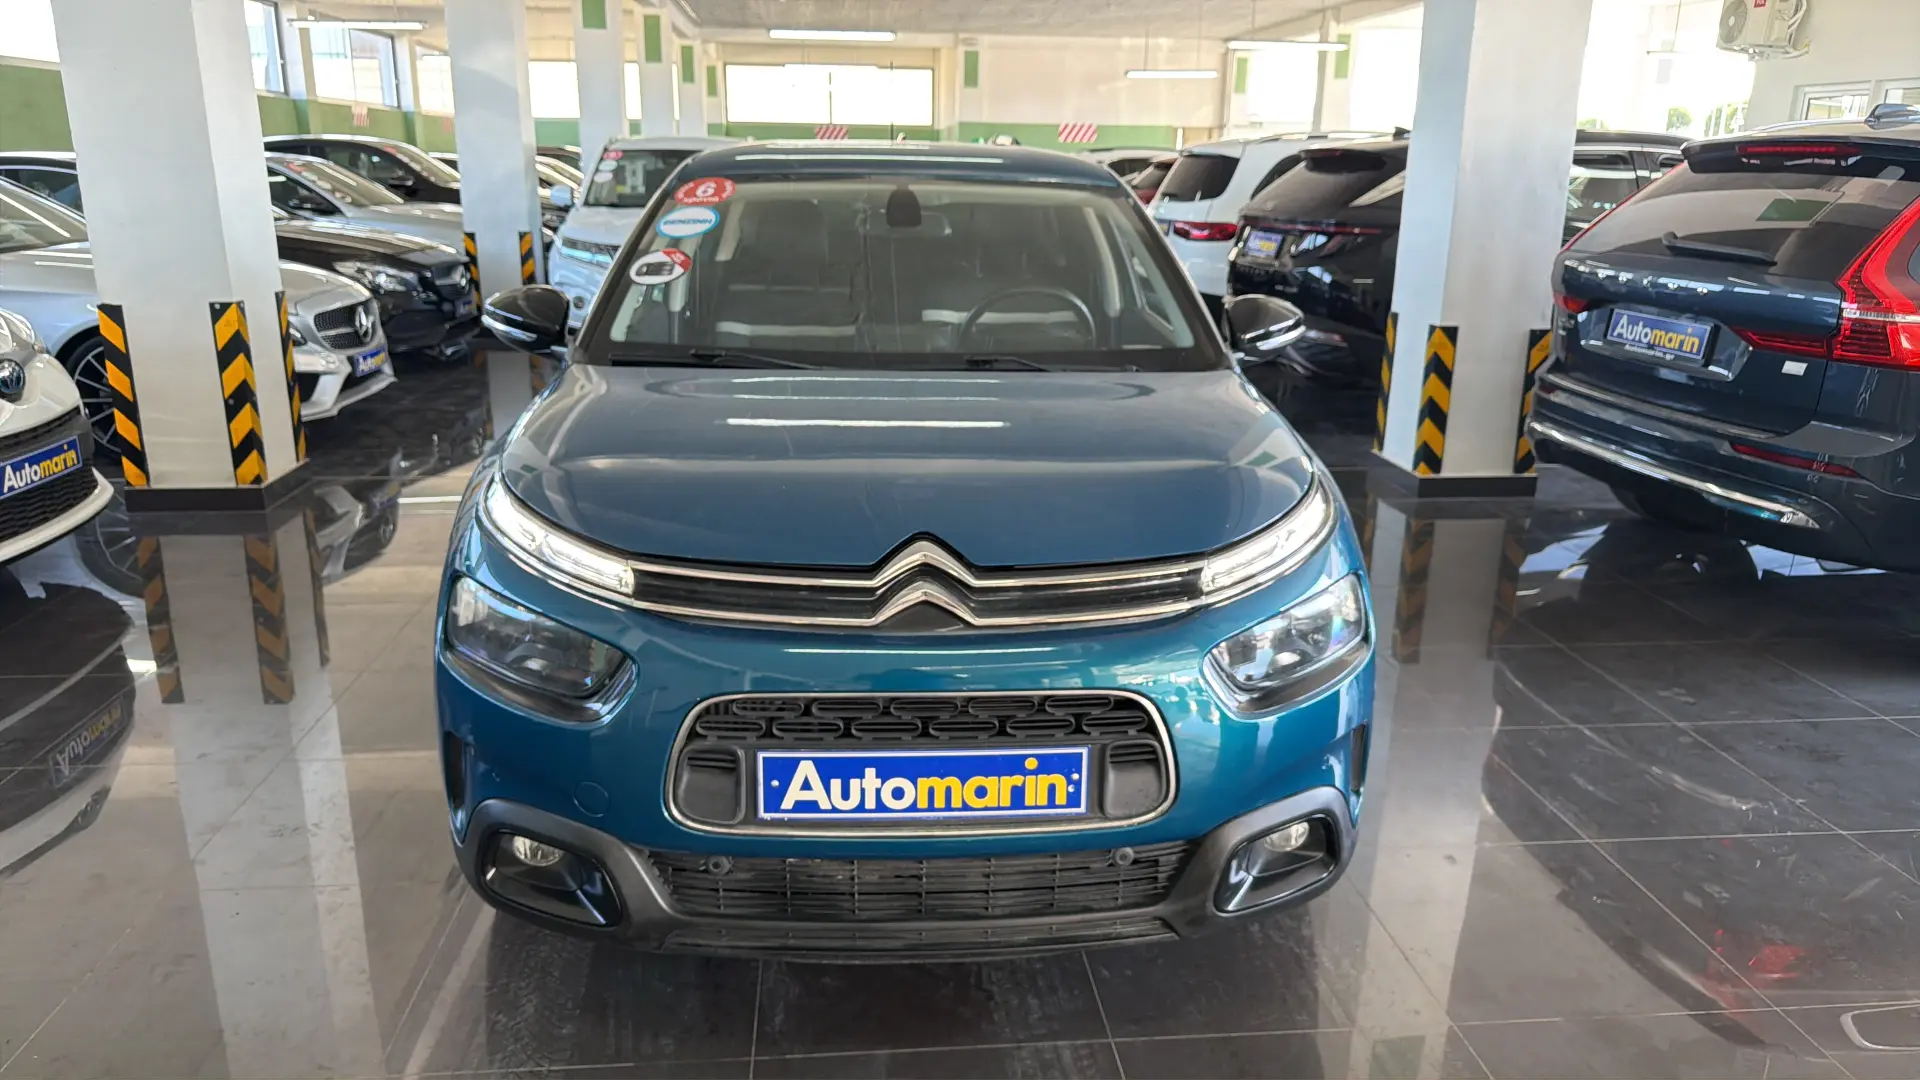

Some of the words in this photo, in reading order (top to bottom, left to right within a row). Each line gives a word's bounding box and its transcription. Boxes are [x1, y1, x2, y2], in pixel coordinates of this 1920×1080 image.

[696, 182, 717, 198] 6
[1613, 314, 1700, 354] Automarin
[4, 444, 78, 494] Automarin
[779, 757, 1068, 810] Automarin
